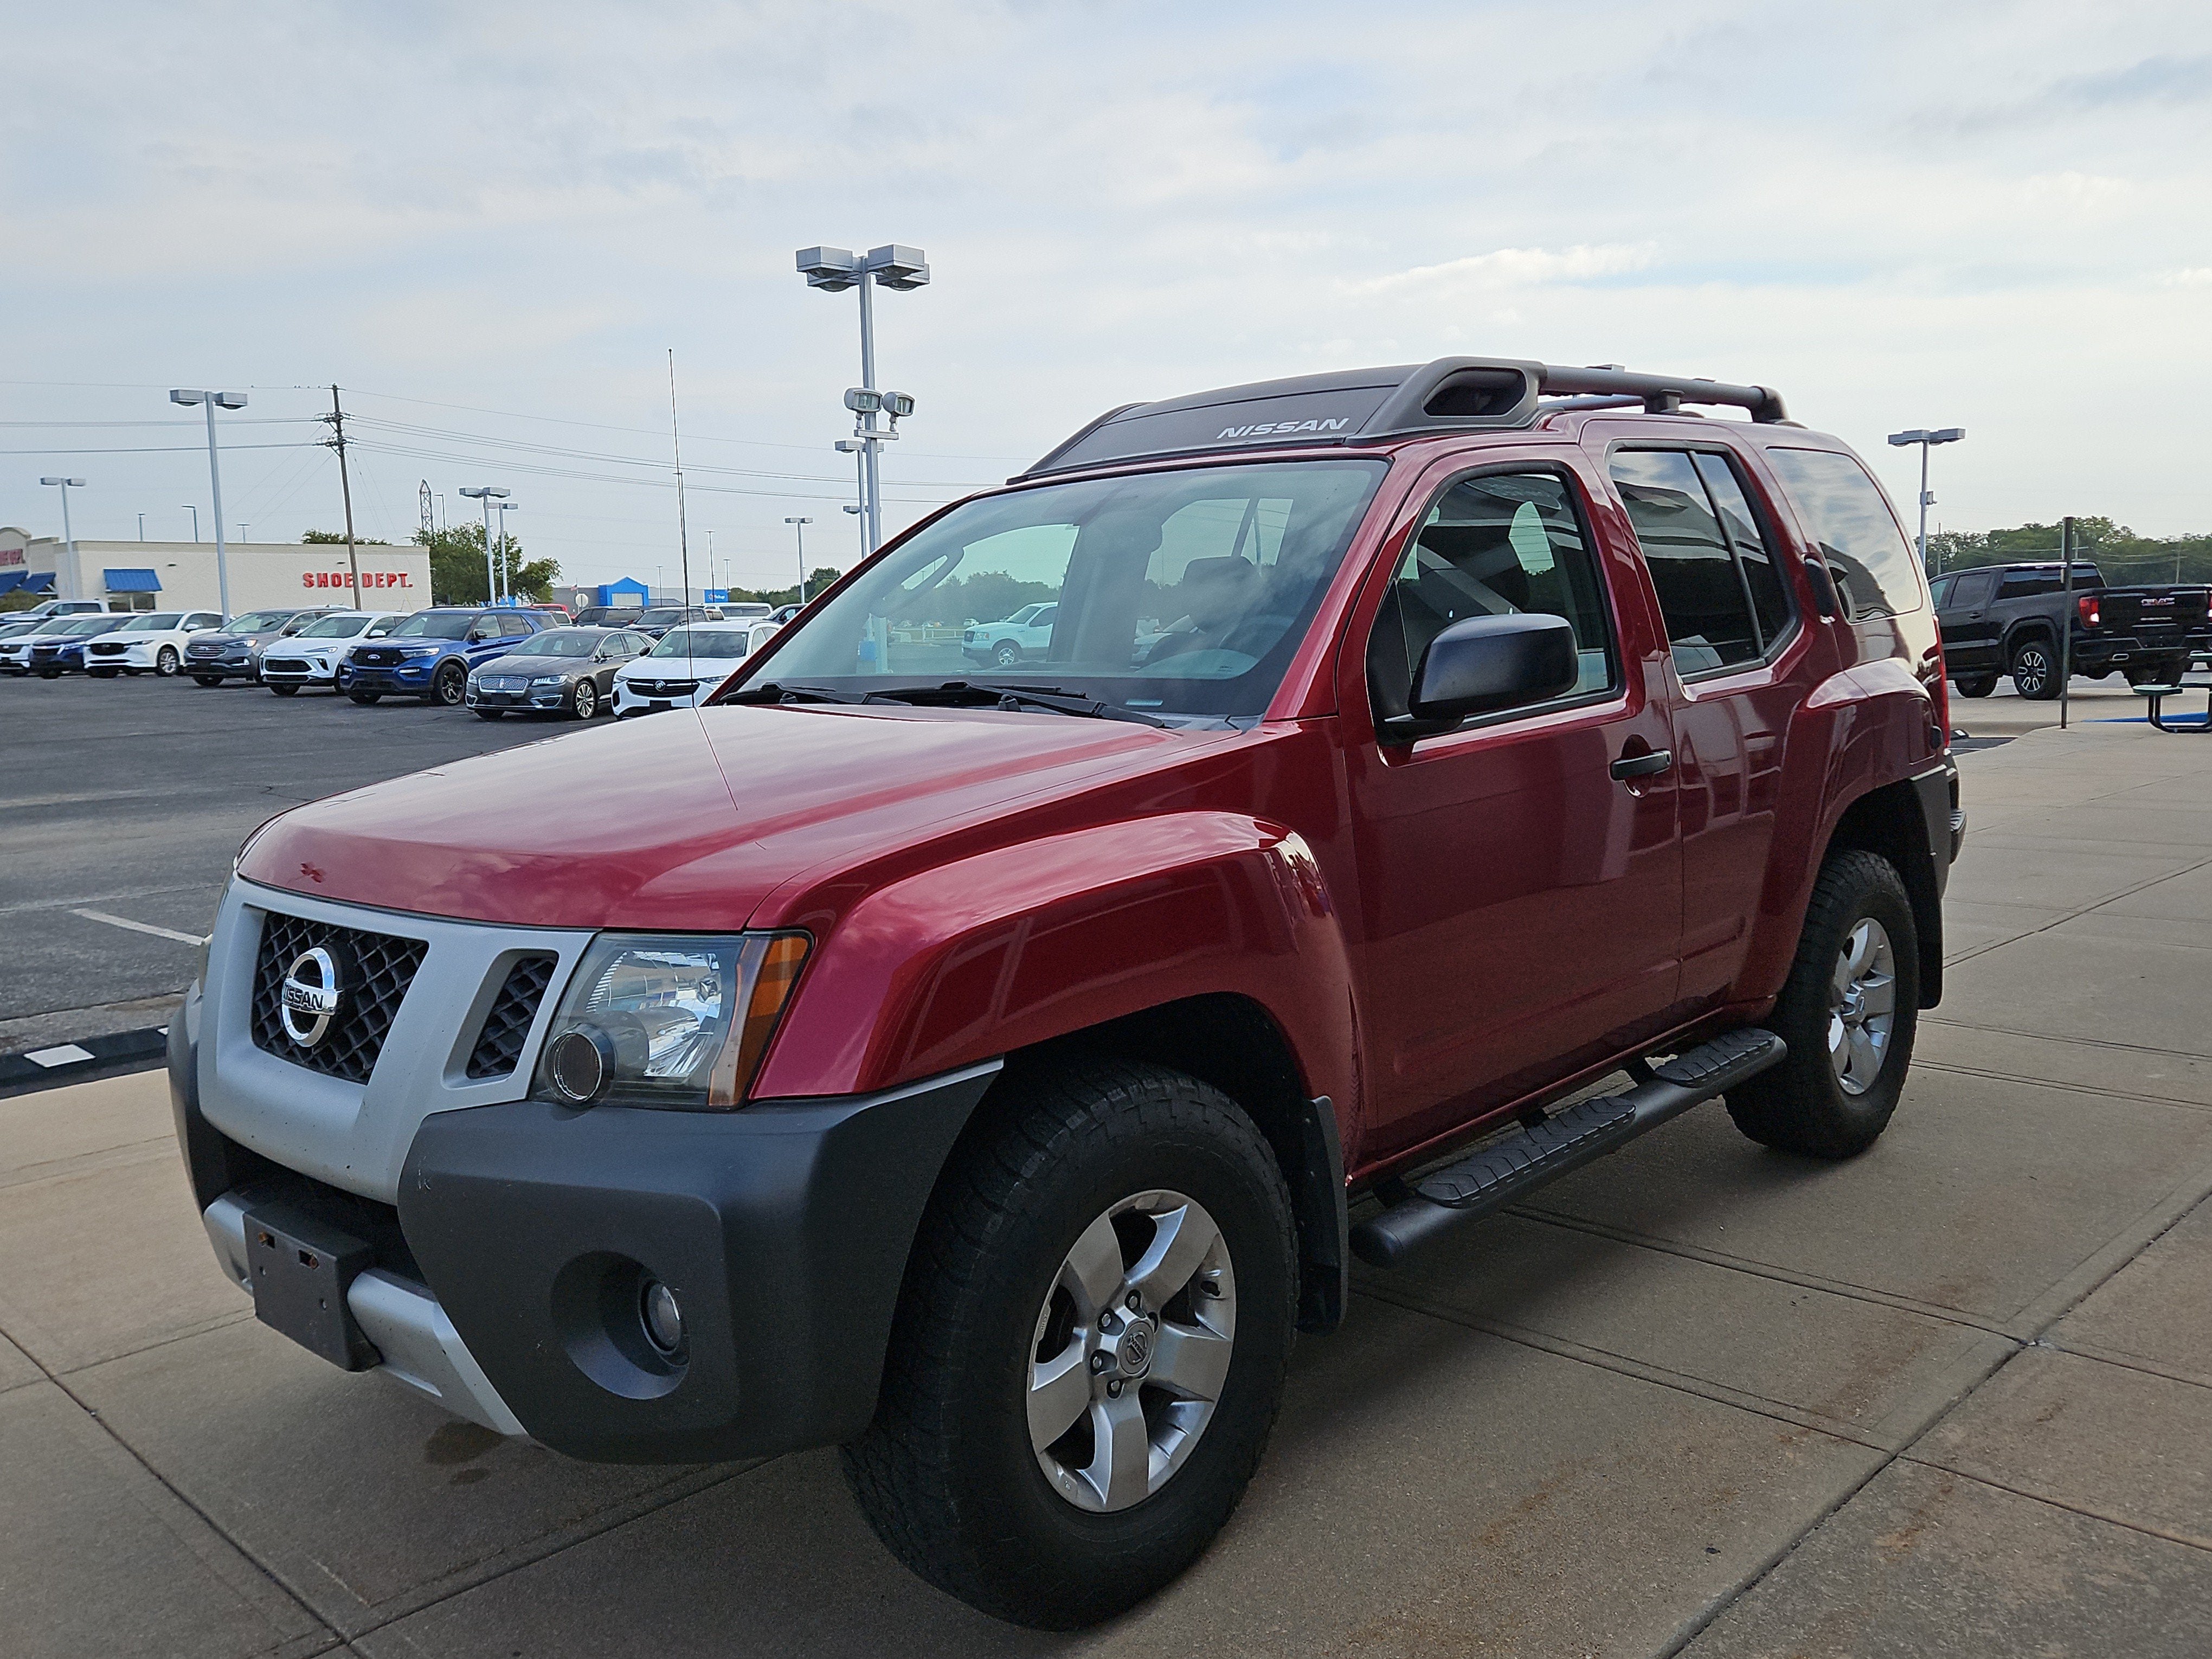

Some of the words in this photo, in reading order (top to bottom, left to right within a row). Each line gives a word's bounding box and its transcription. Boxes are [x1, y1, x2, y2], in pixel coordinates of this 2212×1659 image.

[1217, 418, 1349, 439] NISSAN
[303, 573, 353, 588] SHOE
[362, 573, 413, 588] DEPT.
[2141, 597, 2175, 606] GMC
